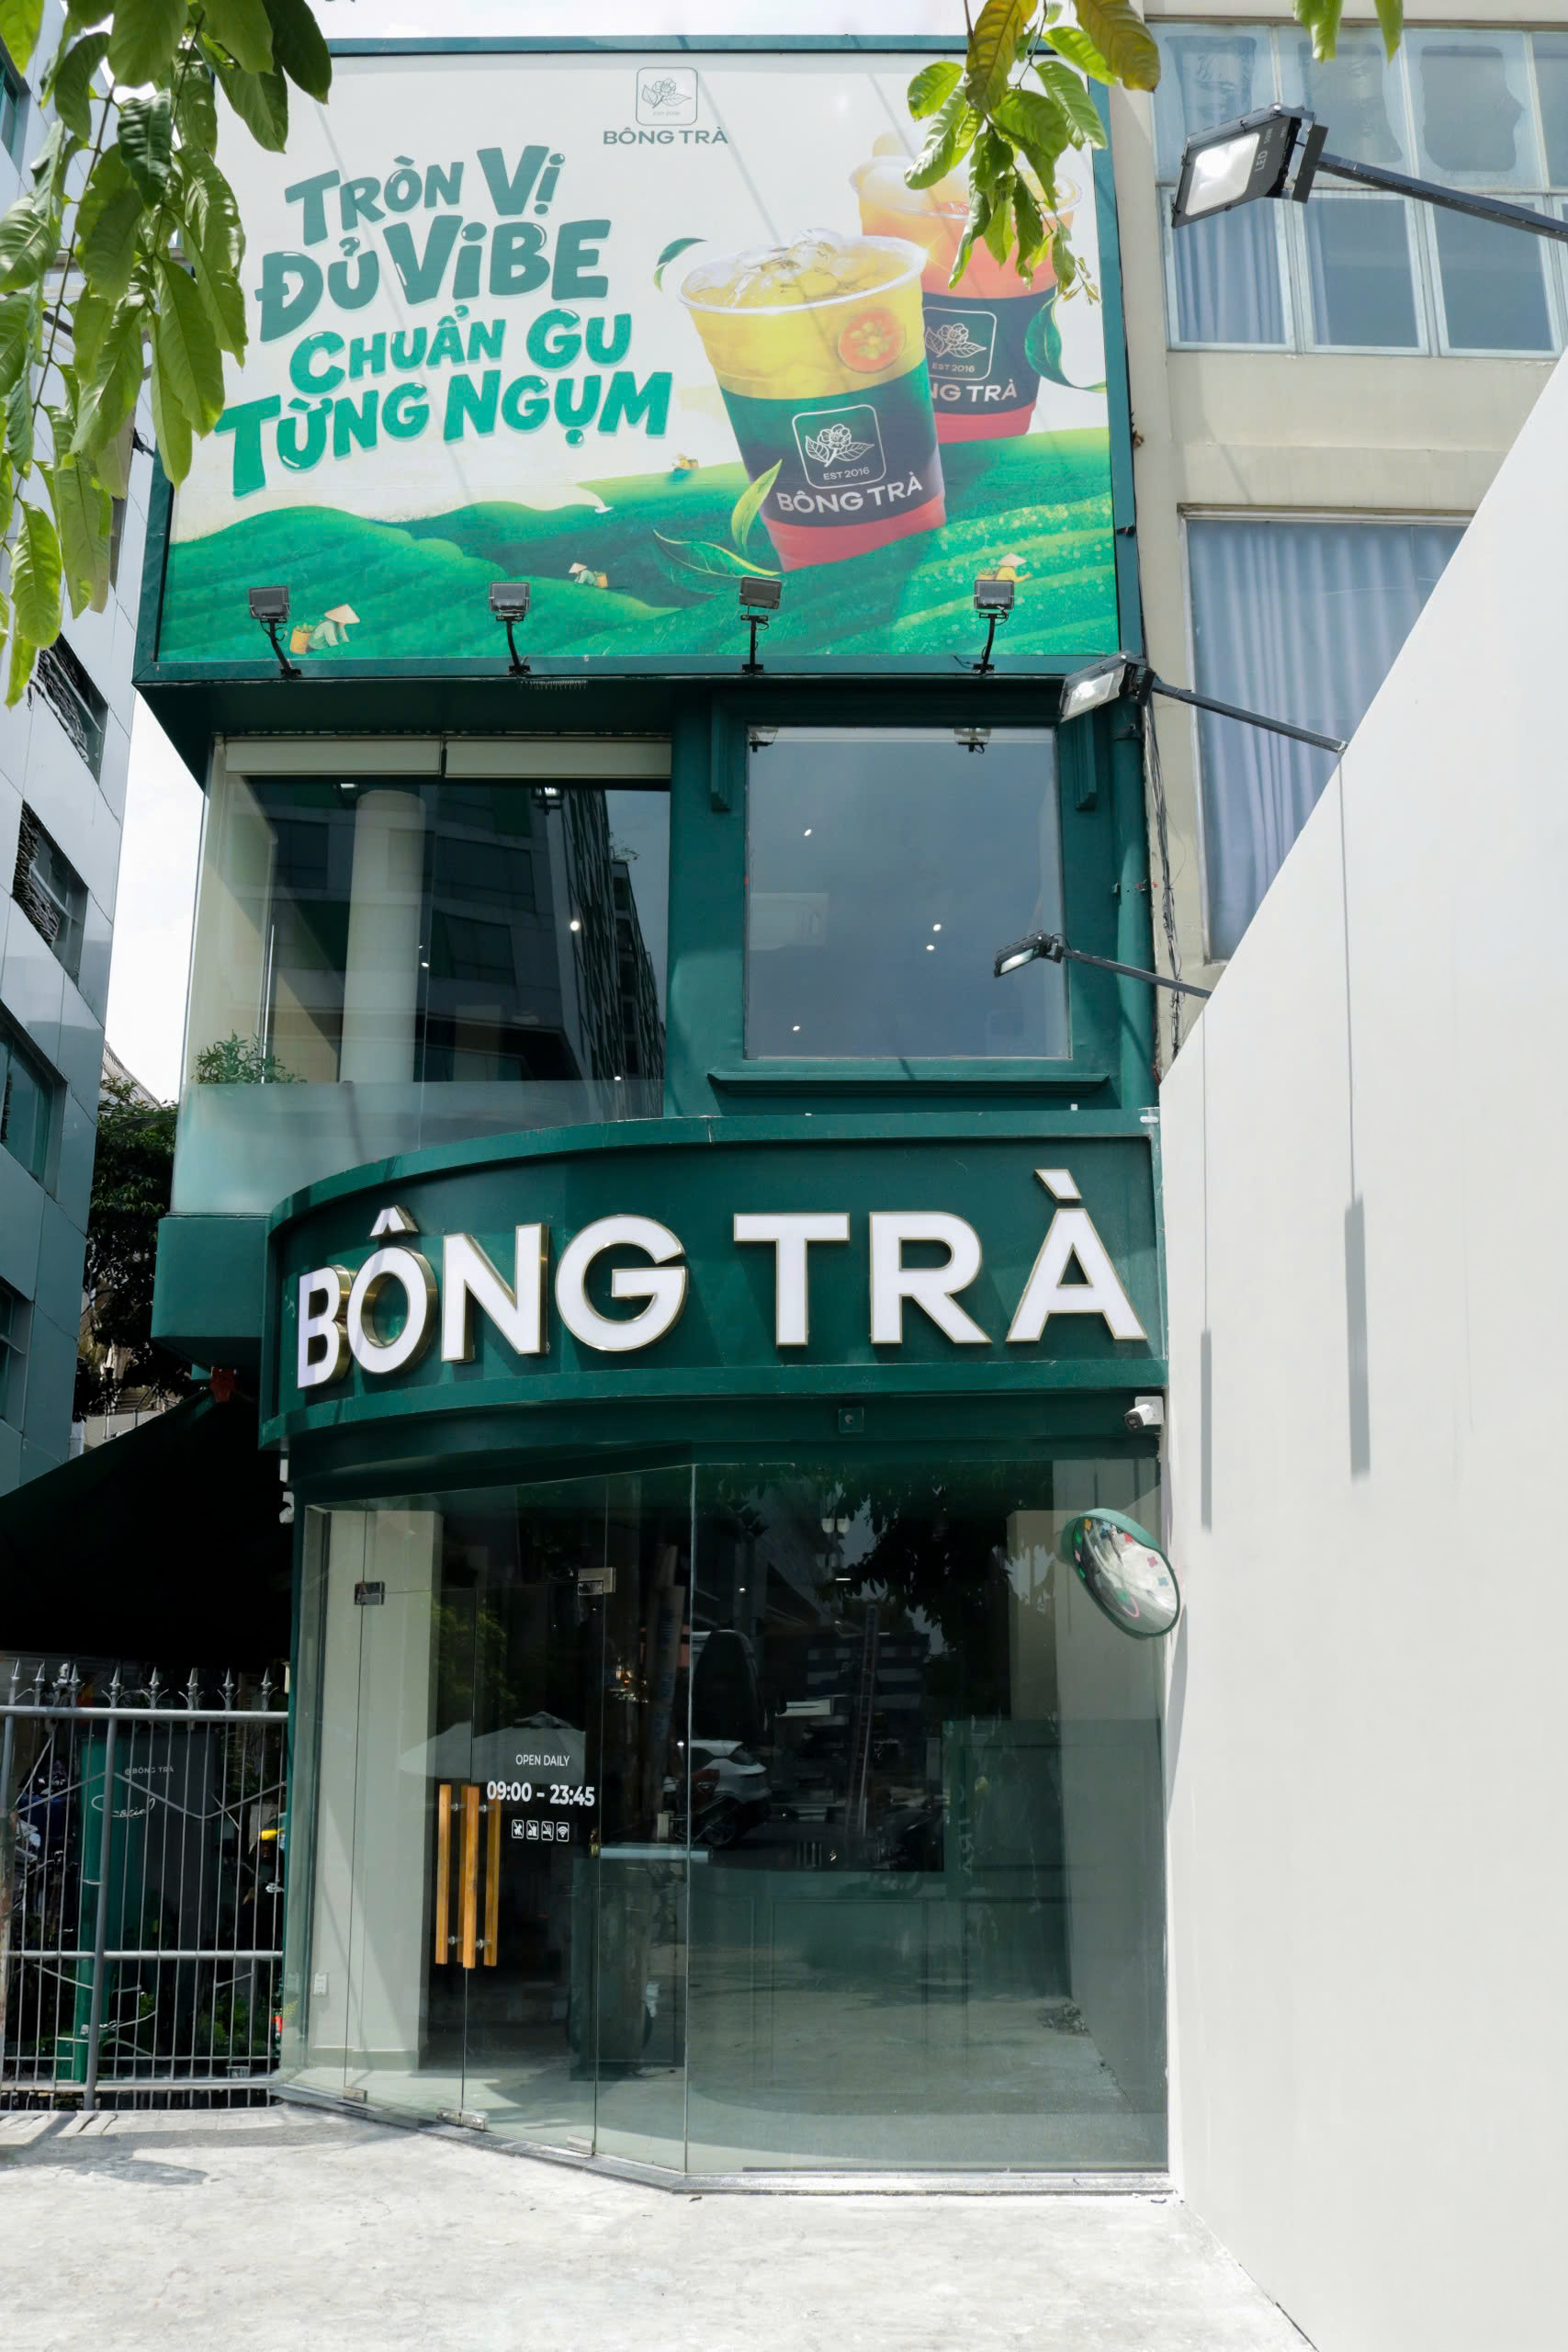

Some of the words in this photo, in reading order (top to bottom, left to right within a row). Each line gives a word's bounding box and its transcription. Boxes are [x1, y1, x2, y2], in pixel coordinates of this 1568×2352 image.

[603, 127, 675, 145] BÔNG
[679, 126, 728, 144] TRÀ
[1256, 151, 1269, 172] LED
[284, 155, 465, 247] TRÒN
[254, 236, 379, 343] ĐỦ
[288, 304, 507, 395] CHUẨN
[525, 308, 632, 369] GU
[932, 363, 951, 371] EST
[951, 364, 976, 373] 2016
[965, 379, 1018, 402] TRÀ
[214, 381, 430, 499] TỪNG
[443, 369, 673, 447] NGỤM
[823, 471, 843, 481] EST
[845, 466, 871, 478] 2016
[776, 490, 863, 514] BÔNG
[866, 470, 923, 506] TRÀ
[297, 1204, 690, 1390] BÔNG
[734, 1168, 1148, 1348] TRÀ
[515, 1754, 541, 1767] OPEN
[543, 1755, 570, 1767] DAILY
[486, 1781, 532, 1803] 09:00
[549, 1784, 595, 1807] 23:45
